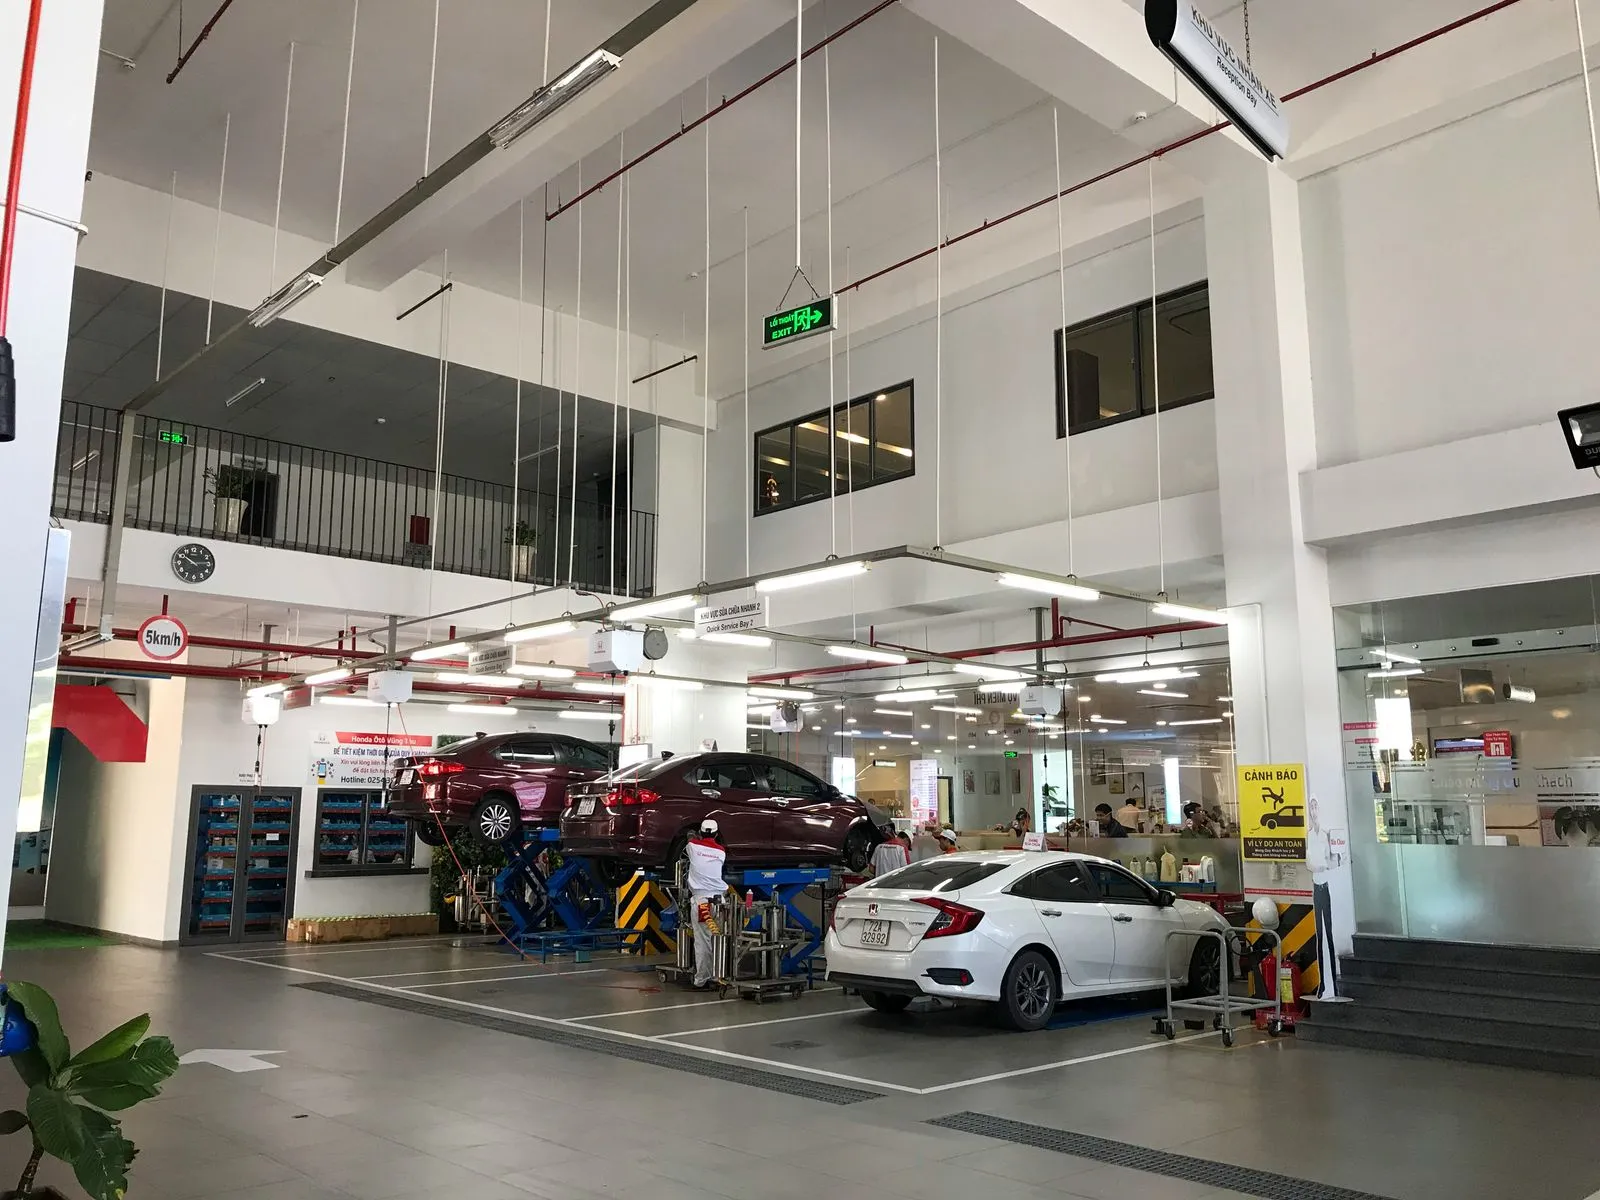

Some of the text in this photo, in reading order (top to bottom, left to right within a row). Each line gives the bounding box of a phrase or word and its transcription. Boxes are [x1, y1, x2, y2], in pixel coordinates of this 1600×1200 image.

[1191, 4, 1212, 39] KHU
[1216, 56, 1258, 108] Reception Bay
[772, 327, 792, 339] EXIT
[721, 623, 738, 631] Service
[740, 620, 749, 628] Bay
[146, 630, 180, 646] 5km/h
[340, 776, 366, 784] Hotline:
[1244, 768, 1298, 781] CẢNH BÁO
[869, 921, 882, 932] 72A
